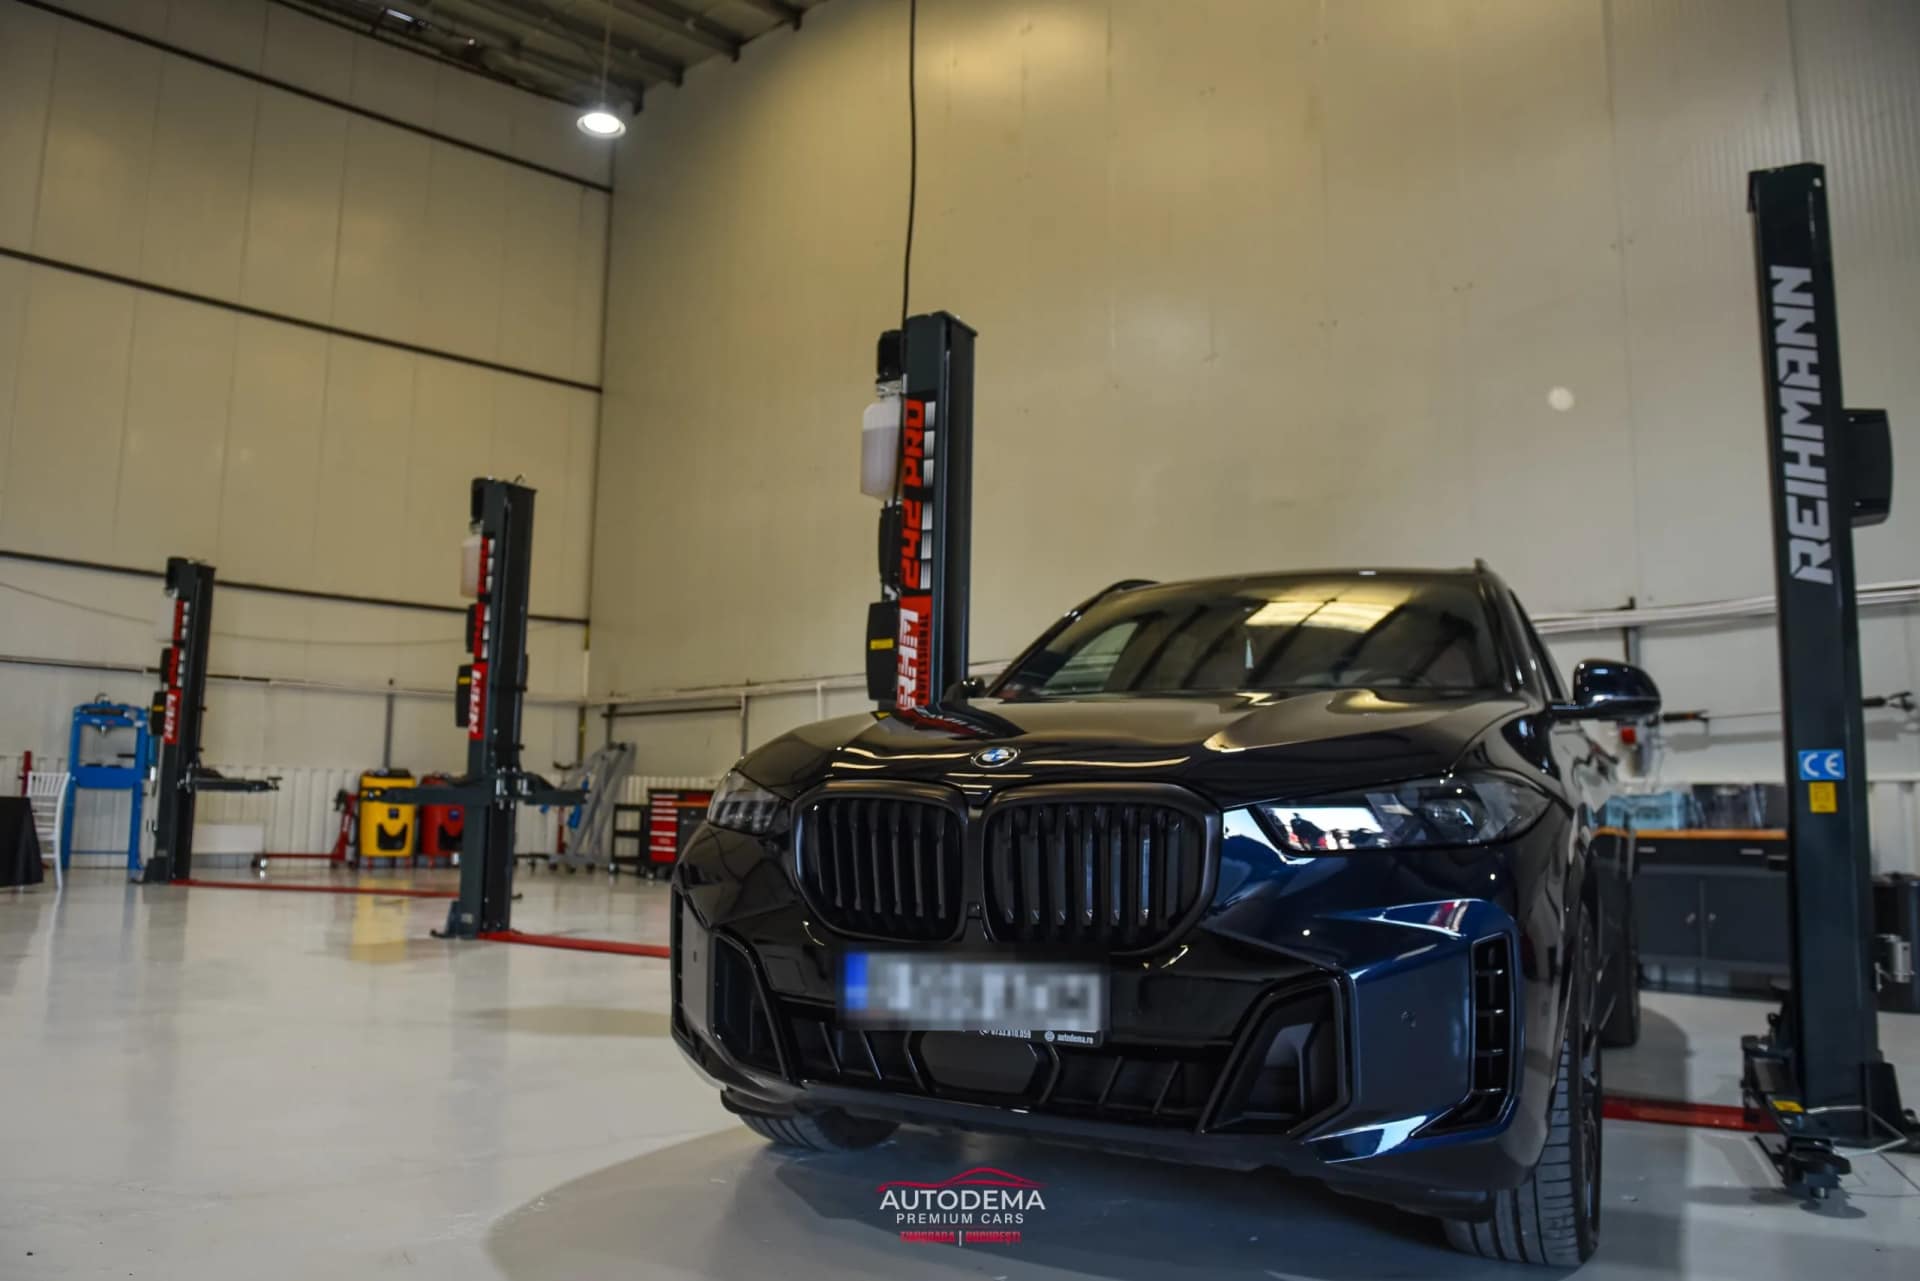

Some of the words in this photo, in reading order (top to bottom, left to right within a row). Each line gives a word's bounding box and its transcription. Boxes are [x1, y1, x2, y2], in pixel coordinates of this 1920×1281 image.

[904, 400, 925, 486] PRO
[1770, 265, 1833, 584] REIHMANN
[901, 499, 921, 589] 242
[1803, 753, 1842, 777] CE
